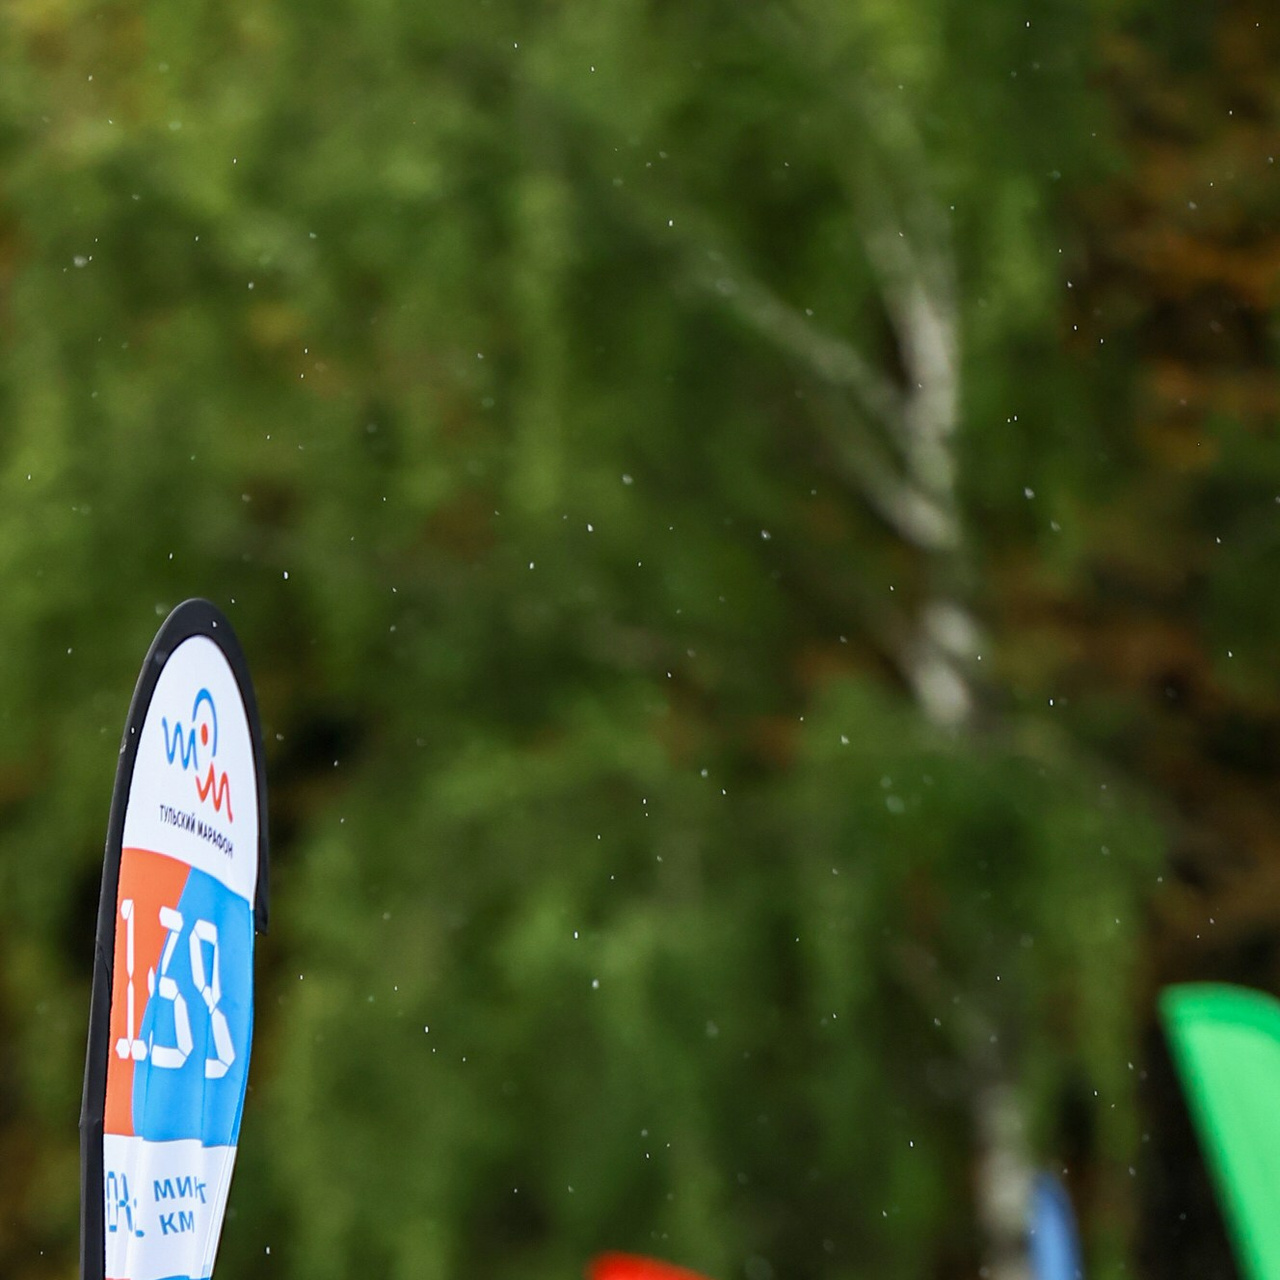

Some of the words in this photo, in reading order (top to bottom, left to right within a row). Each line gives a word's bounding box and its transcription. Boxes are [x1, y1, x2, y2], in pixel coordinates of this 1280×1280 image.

[160, 804, 196, 834] ТУЛЬСКИЙ
[197, 820, 234, 859] МАРАФОН
[159, 1210, 195, 1236] КМ
